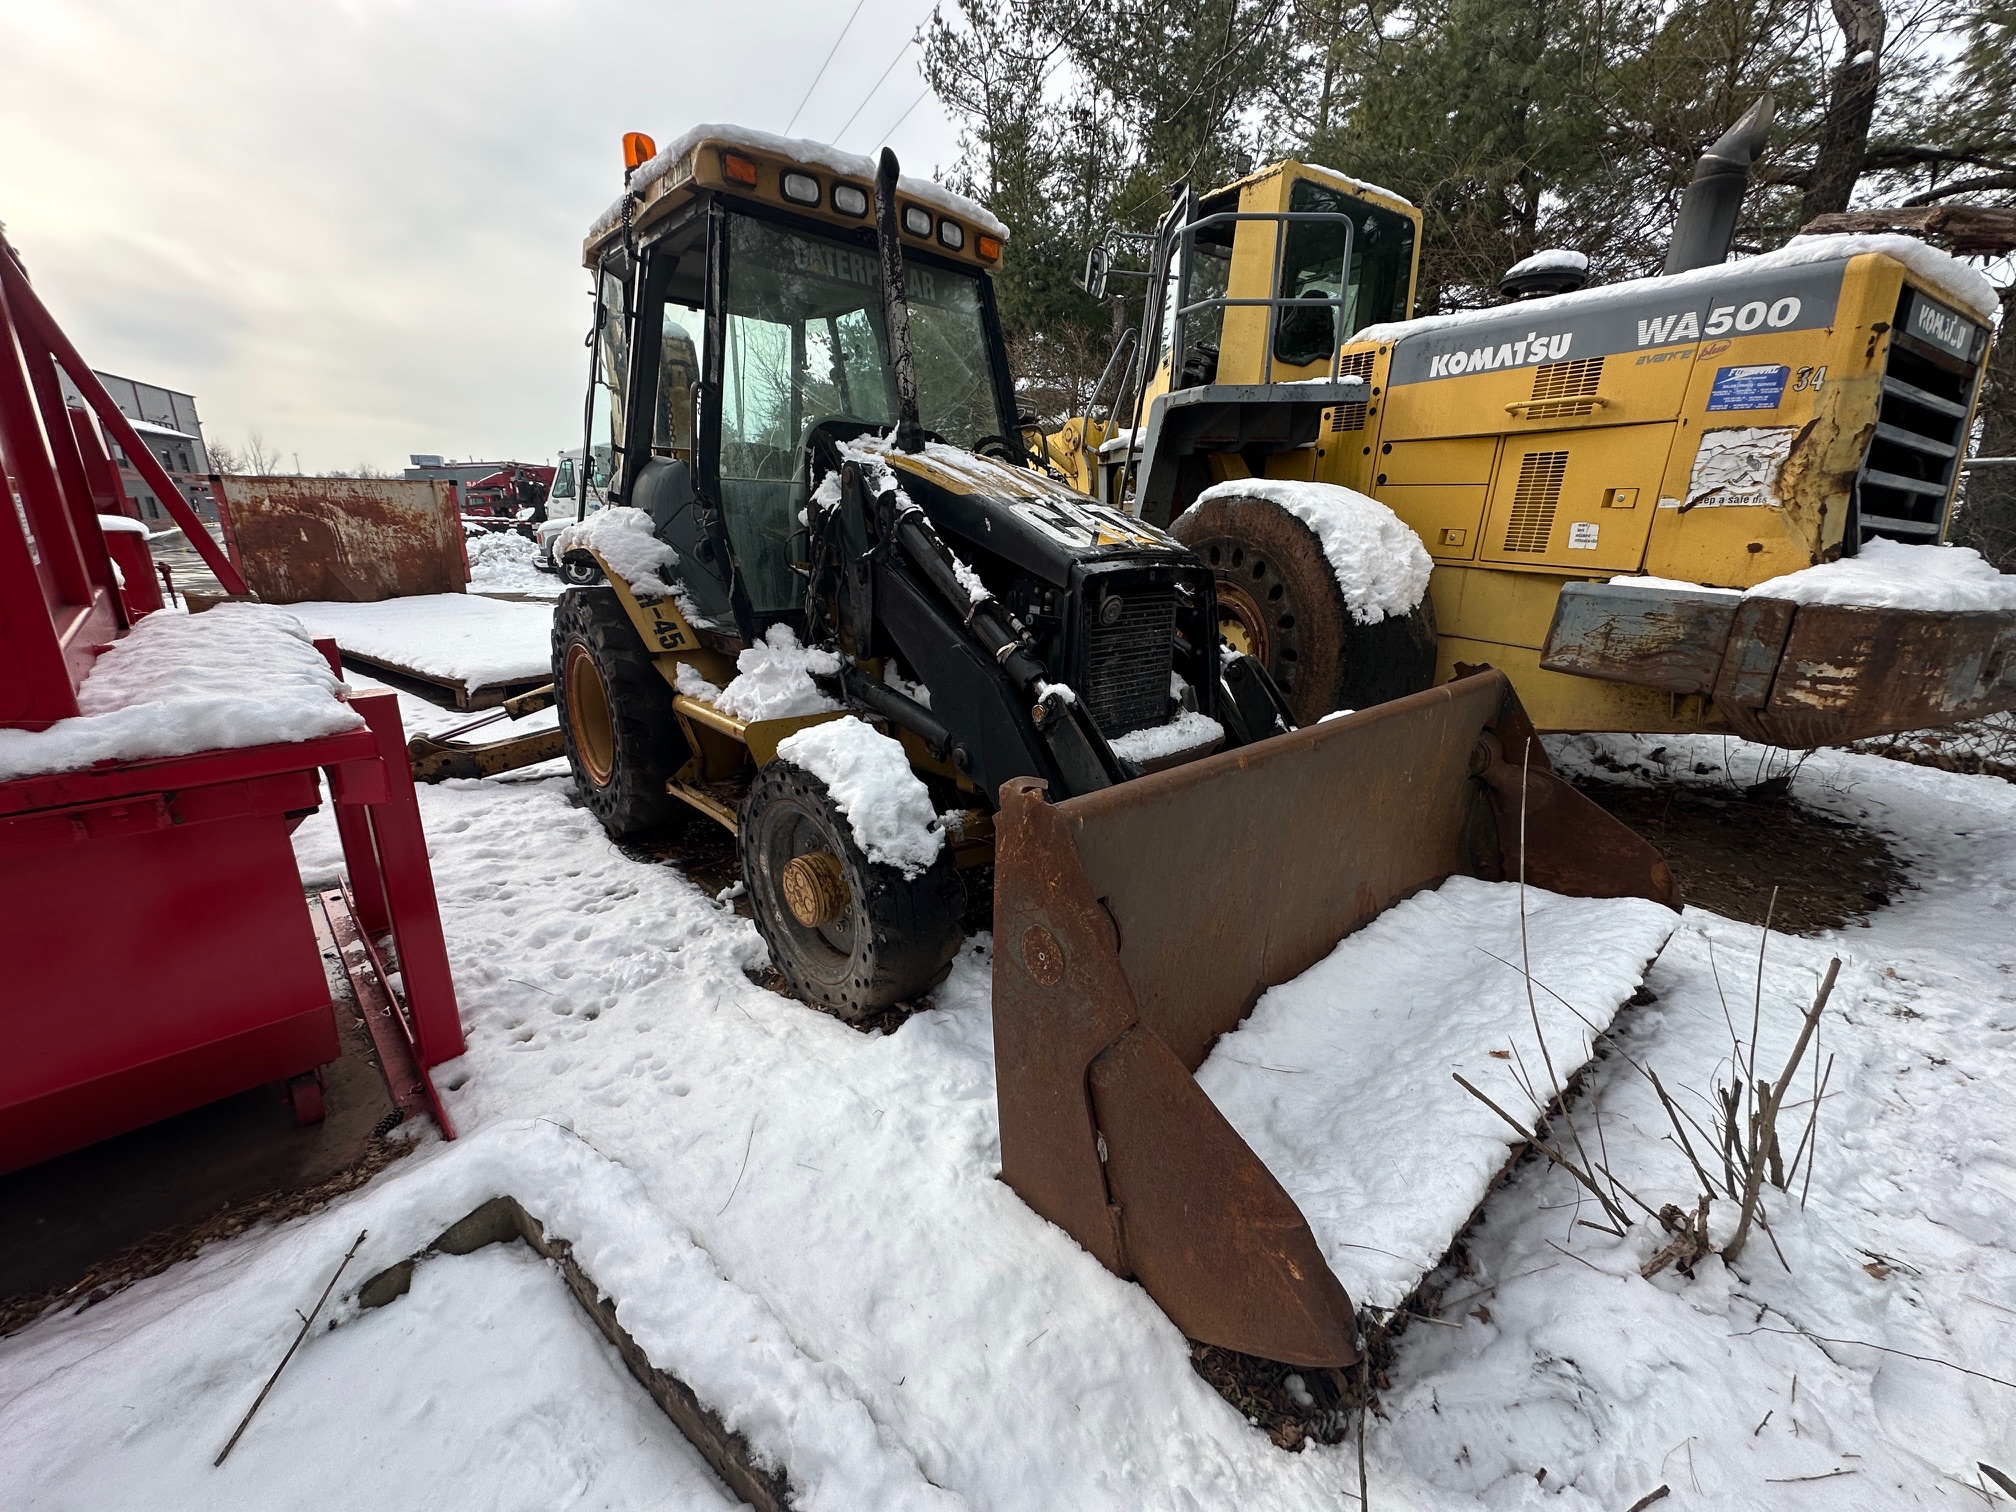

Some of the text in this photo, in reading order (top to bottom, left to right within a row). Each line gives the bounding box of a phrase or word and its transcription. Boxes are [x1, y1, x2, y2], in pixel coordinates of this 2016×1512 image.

[790, 236, 936, 300] CATERPAR
[1637, 297, 1802, 346] WA500
[1918, 304, 1967, 349] KOMATU
[1429, 332, 1573, 378] KOMATSU
[1793, 366, 1828, 392] 34
[1009, 497, 1165, 549] CAT
